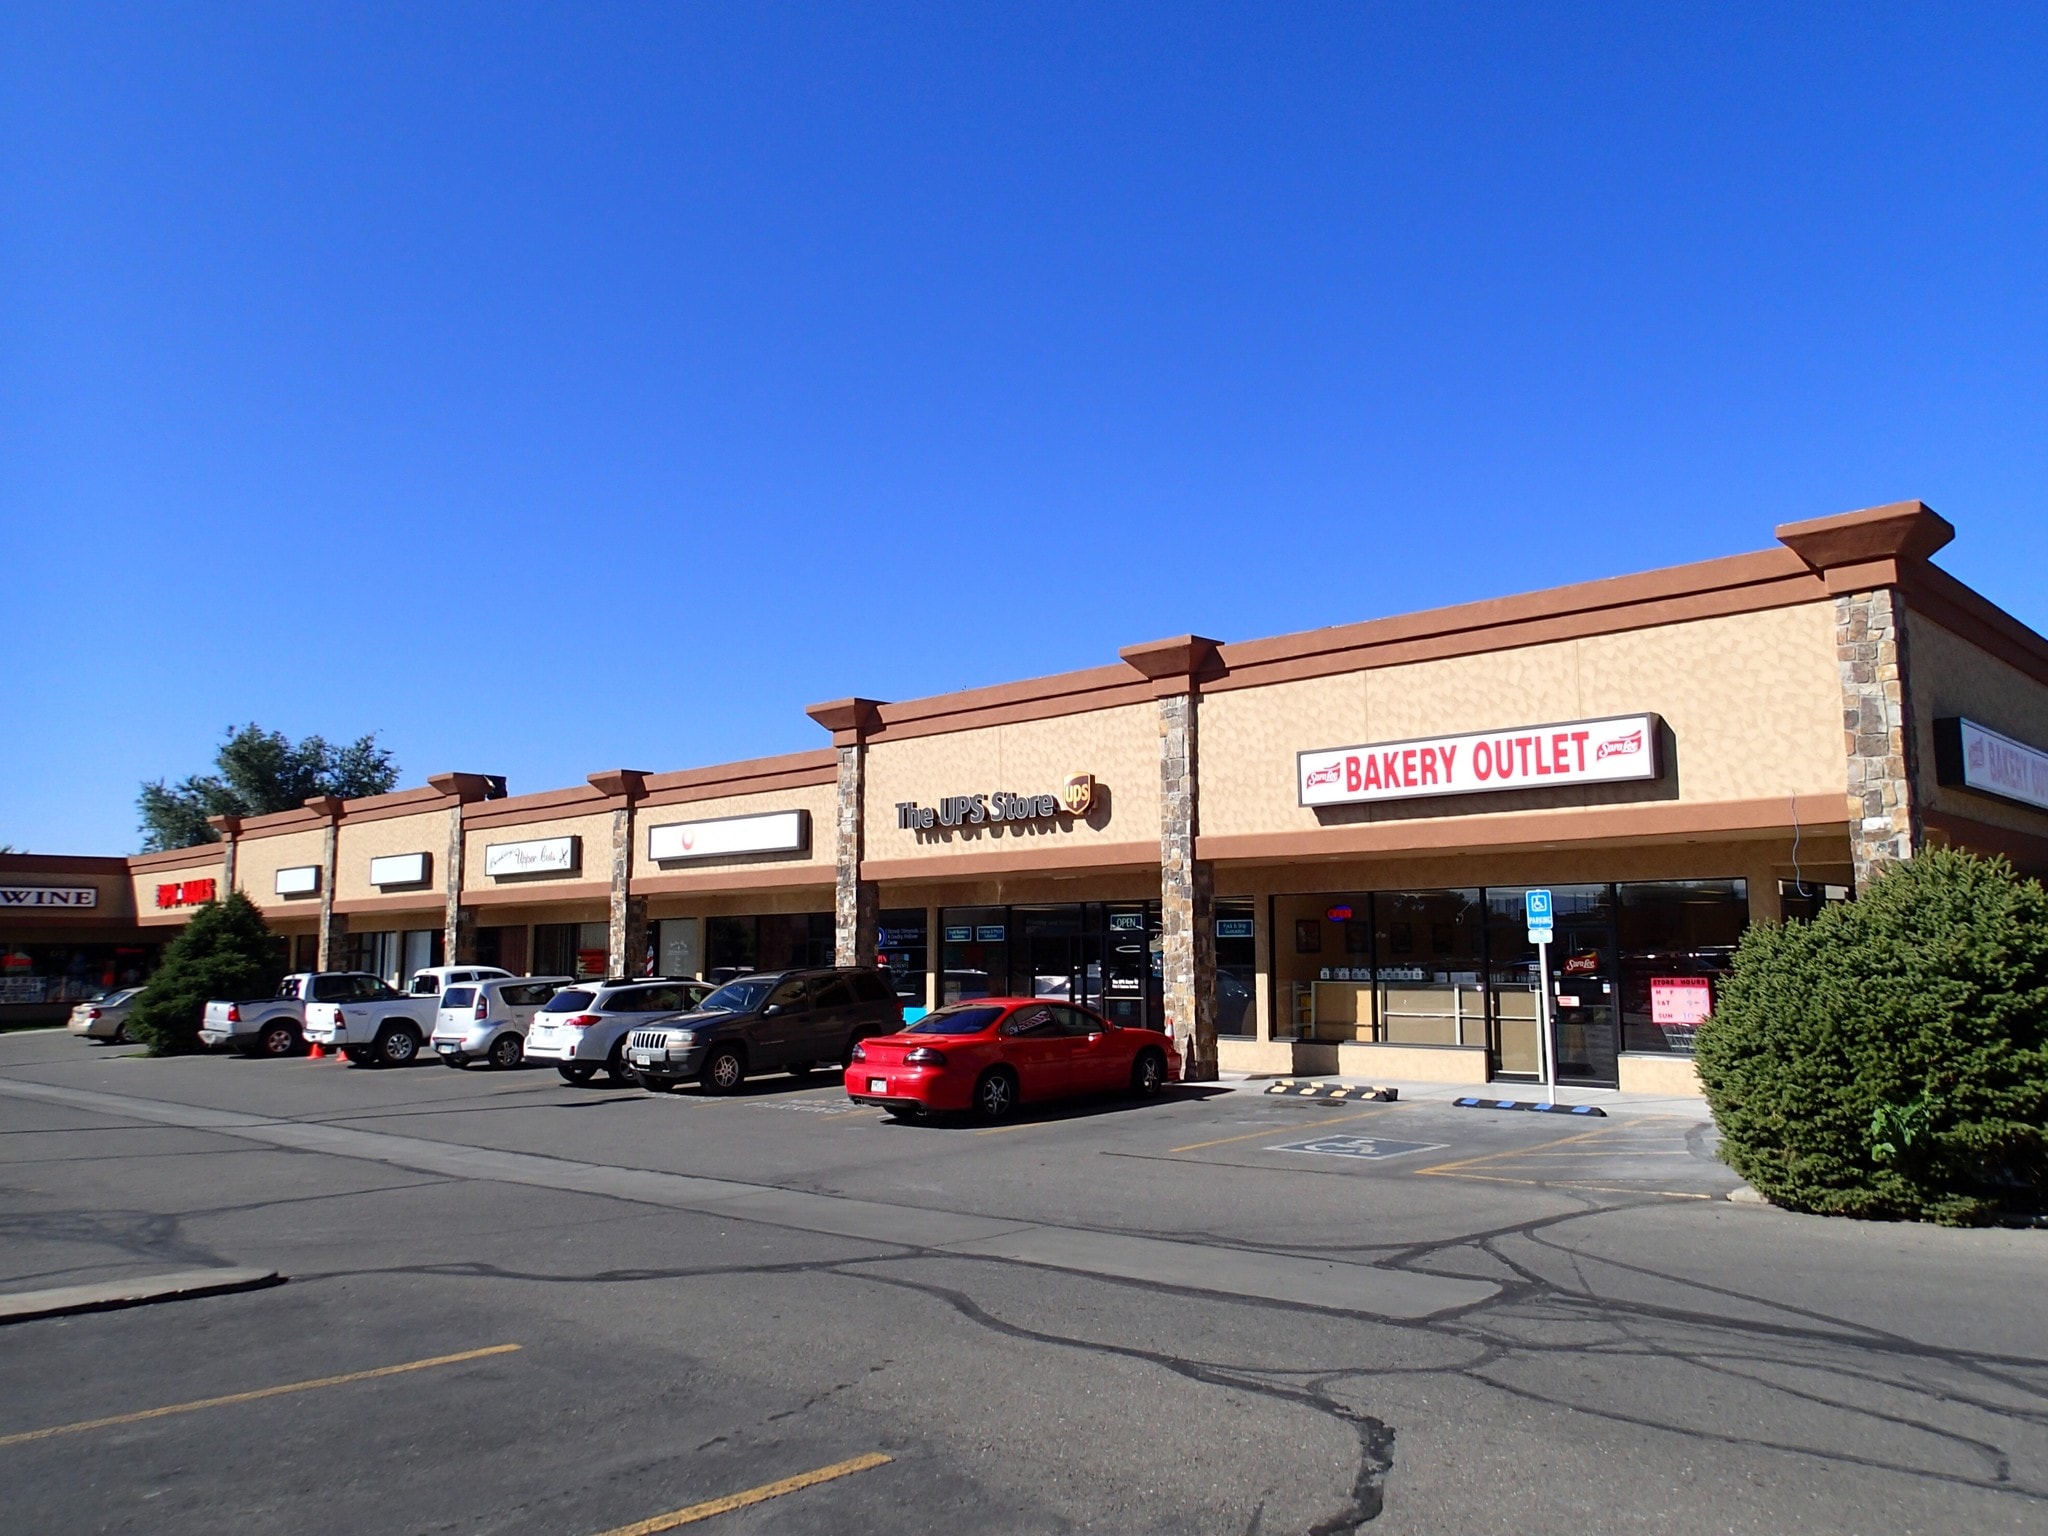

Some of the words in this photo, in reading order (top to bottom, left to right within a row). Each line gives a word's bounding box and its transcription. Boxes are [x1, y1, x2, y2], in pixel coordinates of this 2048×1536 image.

[1598, 742, 1623, 758] Sara
[1621, 739, 1639, 753] Lee
[1345, 745, 1457, 793] BAKERY
[1472, 731, 1590, 782] OUTLET
[1065, 783, 1089, 809] ups
[895, 801, 934, 829] The
[939, 793, 986, 827] UPS
[990, 791, 1055, 822] Store
[0, 890, 92, 905] WINE
[1116, 917, 1137, 928] OPEN
[1528, 916, 1552, 925] PARKING
[1567, 959, 1584, 970] Sara
[1583, 958, 1596, 969] Lee
